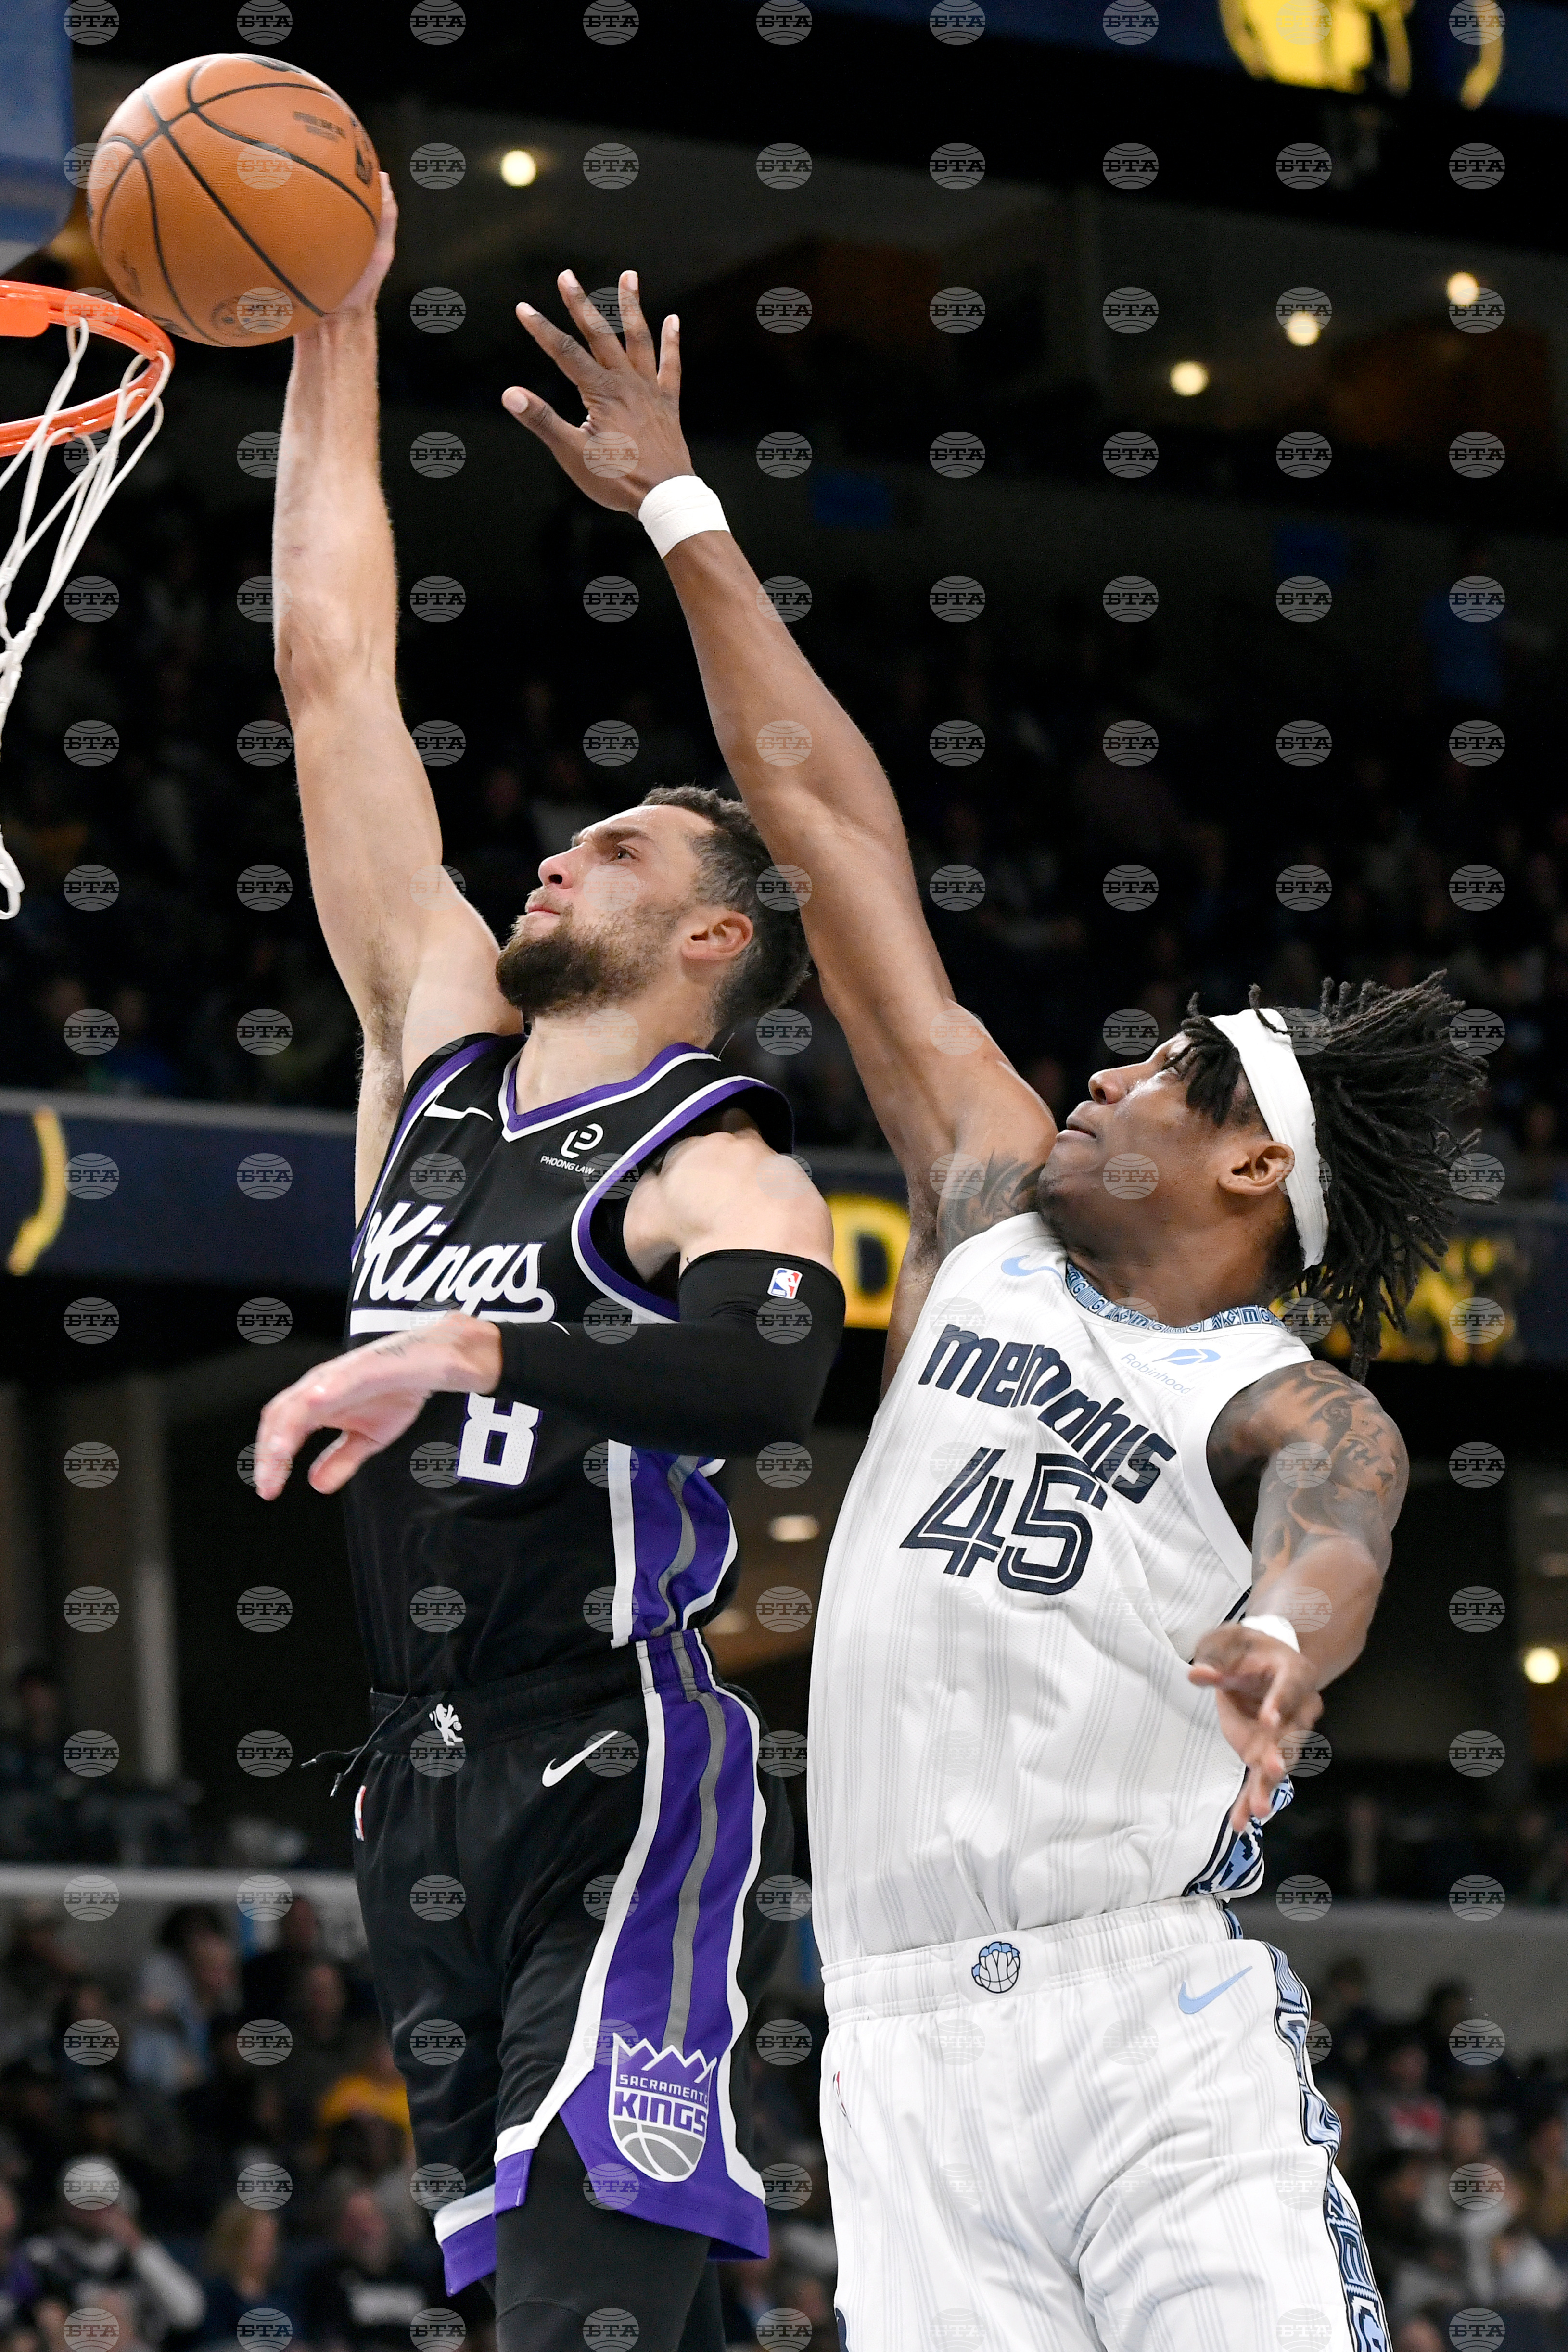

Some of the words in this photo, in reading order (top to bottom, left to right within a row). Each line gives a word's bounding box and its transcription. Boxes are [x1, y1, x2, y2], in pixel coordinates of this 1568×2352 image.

[540, 1155, 576, 1171] PHOONG
[574, 1165, 595, 1175] LAW
[351, 1200, 554, 1318] Kings
[1121, 1353, 1196, 1394] Robinhood
[457, 1392, 541, 1488] 8
[899, 1446, 1108, 1595] 45
[613, 2091, 707, 2138] KINGS
